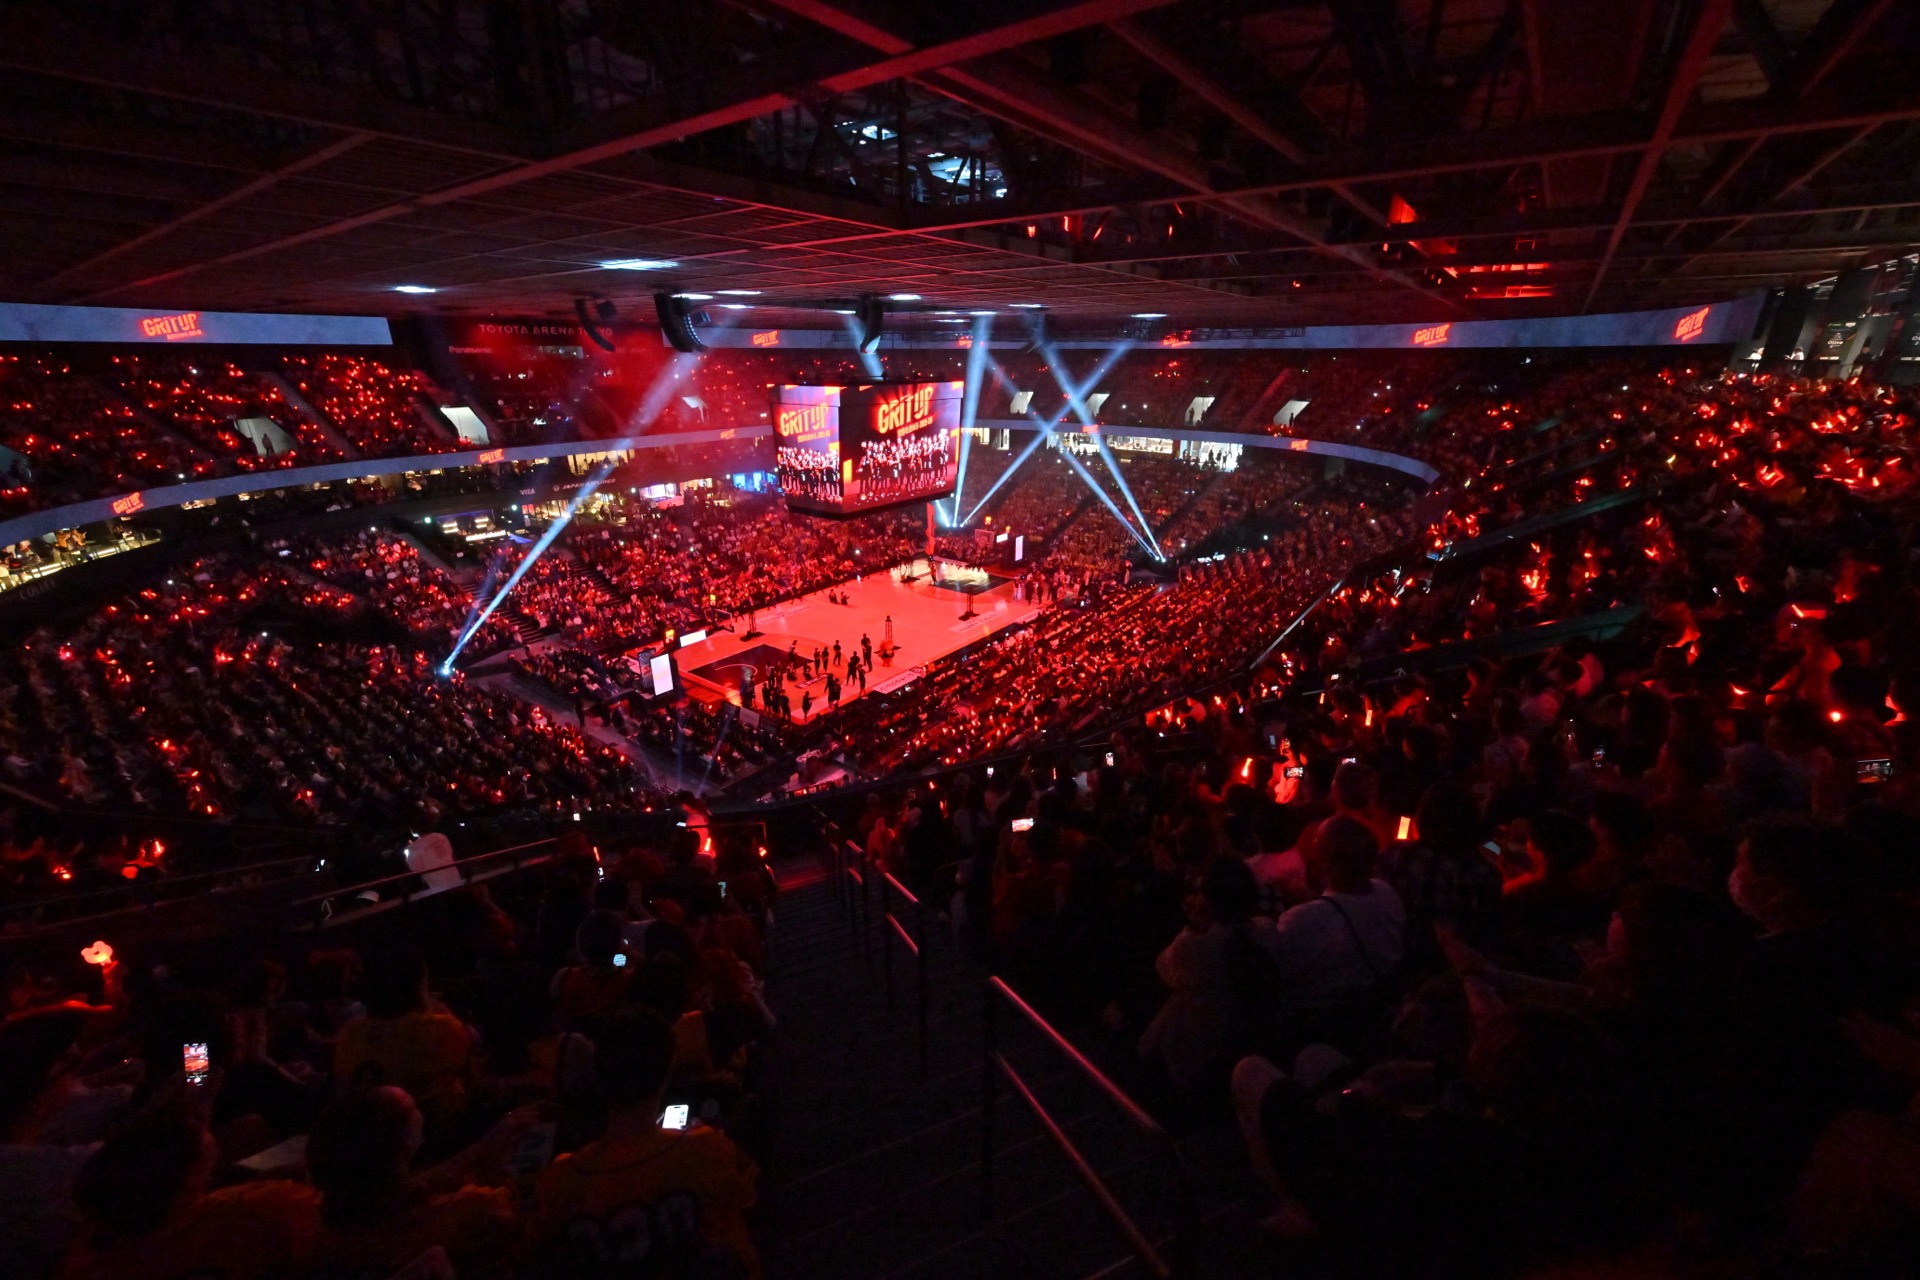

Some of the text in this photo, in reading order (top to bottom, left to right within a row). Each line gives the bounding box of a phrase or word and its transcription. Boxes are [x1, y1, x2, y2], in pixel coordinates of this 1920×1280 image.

[478, 323, 529, 335] TOYOTA
[533, 326, 575, 335] ARENA
[448, 345, 493, 354] Panasonic
[878, 395, 914, 434] GRIT
[914, 386, 933, 420] UP
[780, 408, 810, 437] GRIT
[810, 402, 829, 431] UP
[562, 482, 585, 490] JAPAN
[519, 487, 536, 496] VISA
